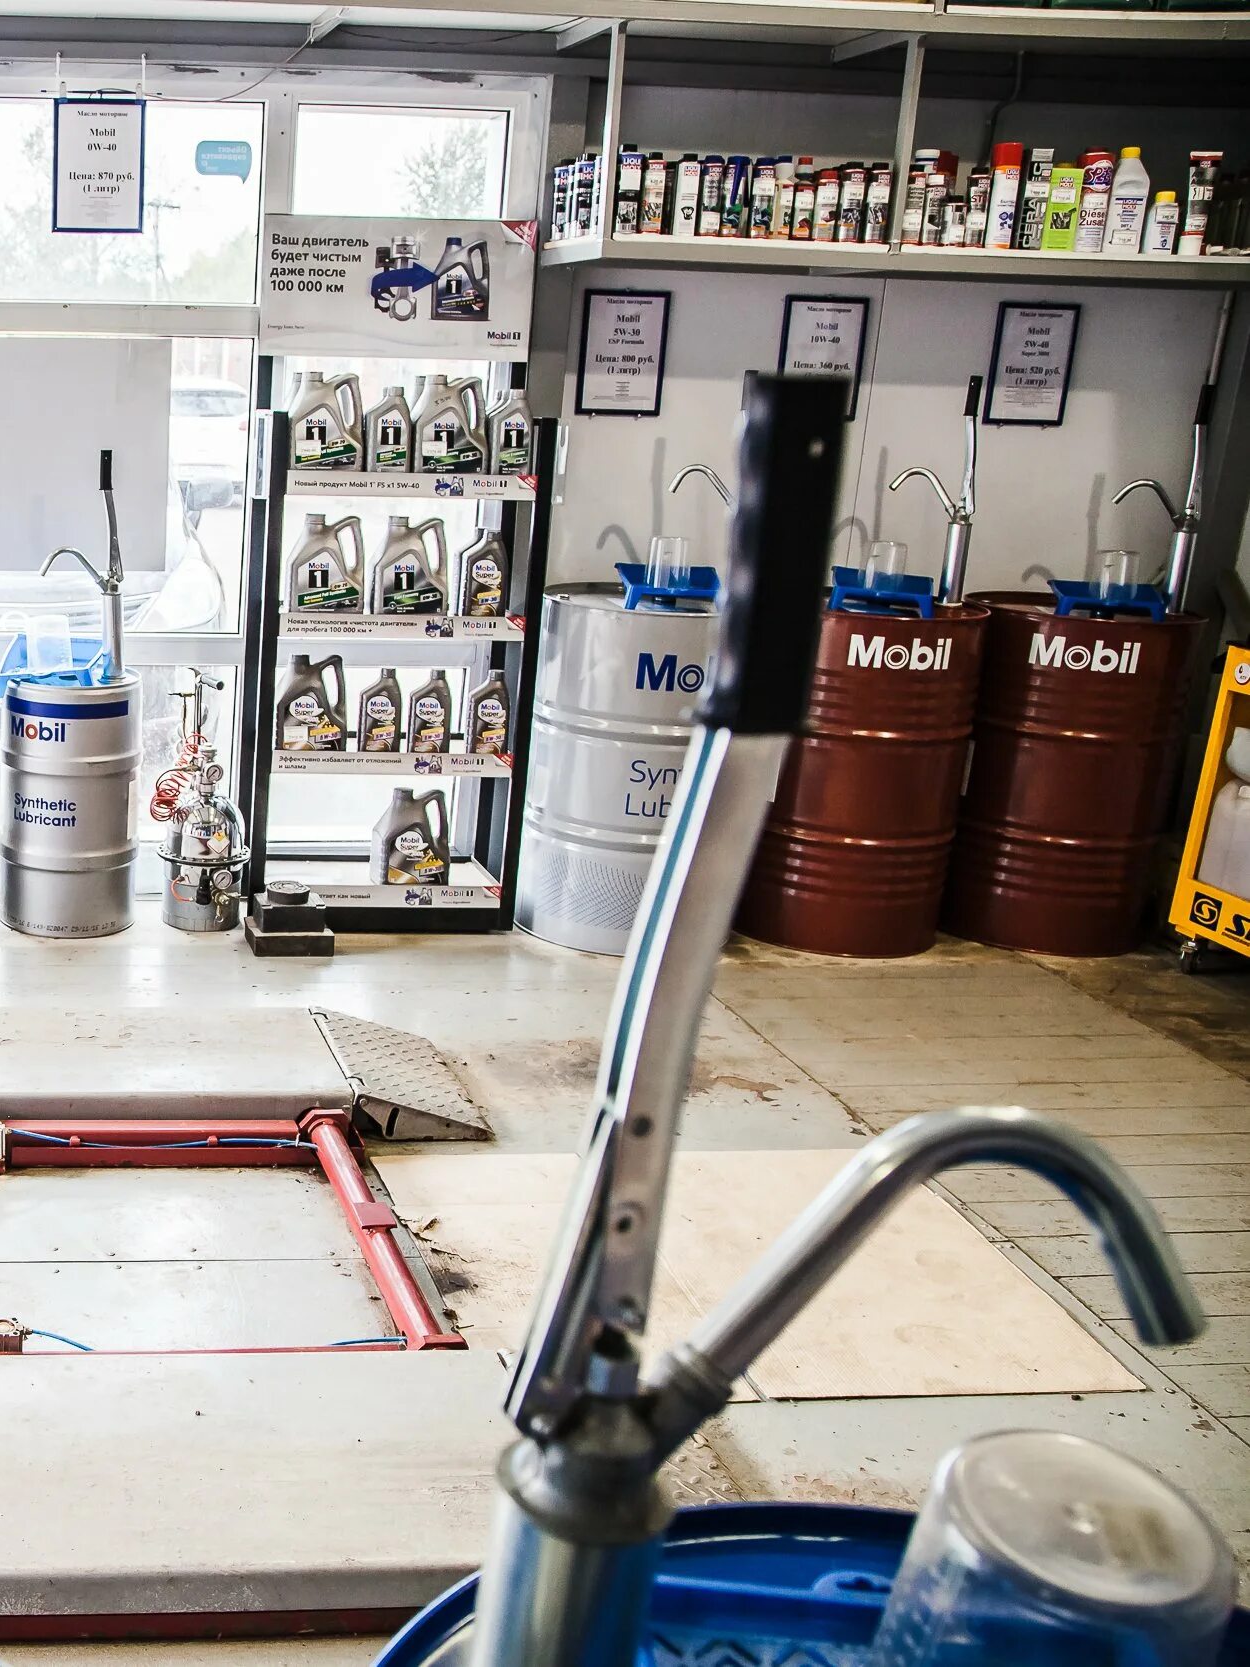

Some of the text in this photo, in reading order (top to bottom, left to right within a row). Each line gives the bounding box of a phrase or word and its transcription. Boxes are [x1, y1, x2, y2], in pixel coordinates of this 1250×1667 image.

[89, 128, 116, 137] Mobil
[87, 143, 117, 152] 0W-40
[69, 171, 135, 182] Цена: 870 руб.
[94, 184, 121, 194] литр)
[272, 233, 370, 248] Ваш двигатель
[271, 249, 362, 263] будет чистым
[270, 266, 346, 279] даже после
[270, 280, 344, 293] 100 000 км
[616, 314, 641, 324] Mobil
[613, 327, 641, 336] 5W-30
[815, 322, 839, 331] Mobil
[1027, 327, 1051, 336] Mobil
[487, 331, 512, 341] Mobil
[810, 335, 841, 344] 10W-40
[1024, 340, 1050, 349] 5W-40
[595, 354, 655, 366] Цена: 800 руб.
[617, 366, 641, 376] литр)
[793, 361, 851, 371] Цена: 360 руб.
[1005, 366, 1061, 376] Цена: 520 руб.
[1024, 378, 1048, 387] литр)
[472, 480, 498, 488] Mobil
[300, 626, 328, 634] пробега
[462, 621, 487, 629] Mobil
[847, 634, 952, 671] Mobil
[1028, 633, 1141, 674] Mobil
[481, 703, 500, 711] Mobil
[480, 710, 499, 718] Super
[11, 717, 66, 743] Mobil
[451, 758, 475, 766] Mobil
[14, 792, 77, 813] Synthetic
[14, 809, 77, 828] Lubricant
